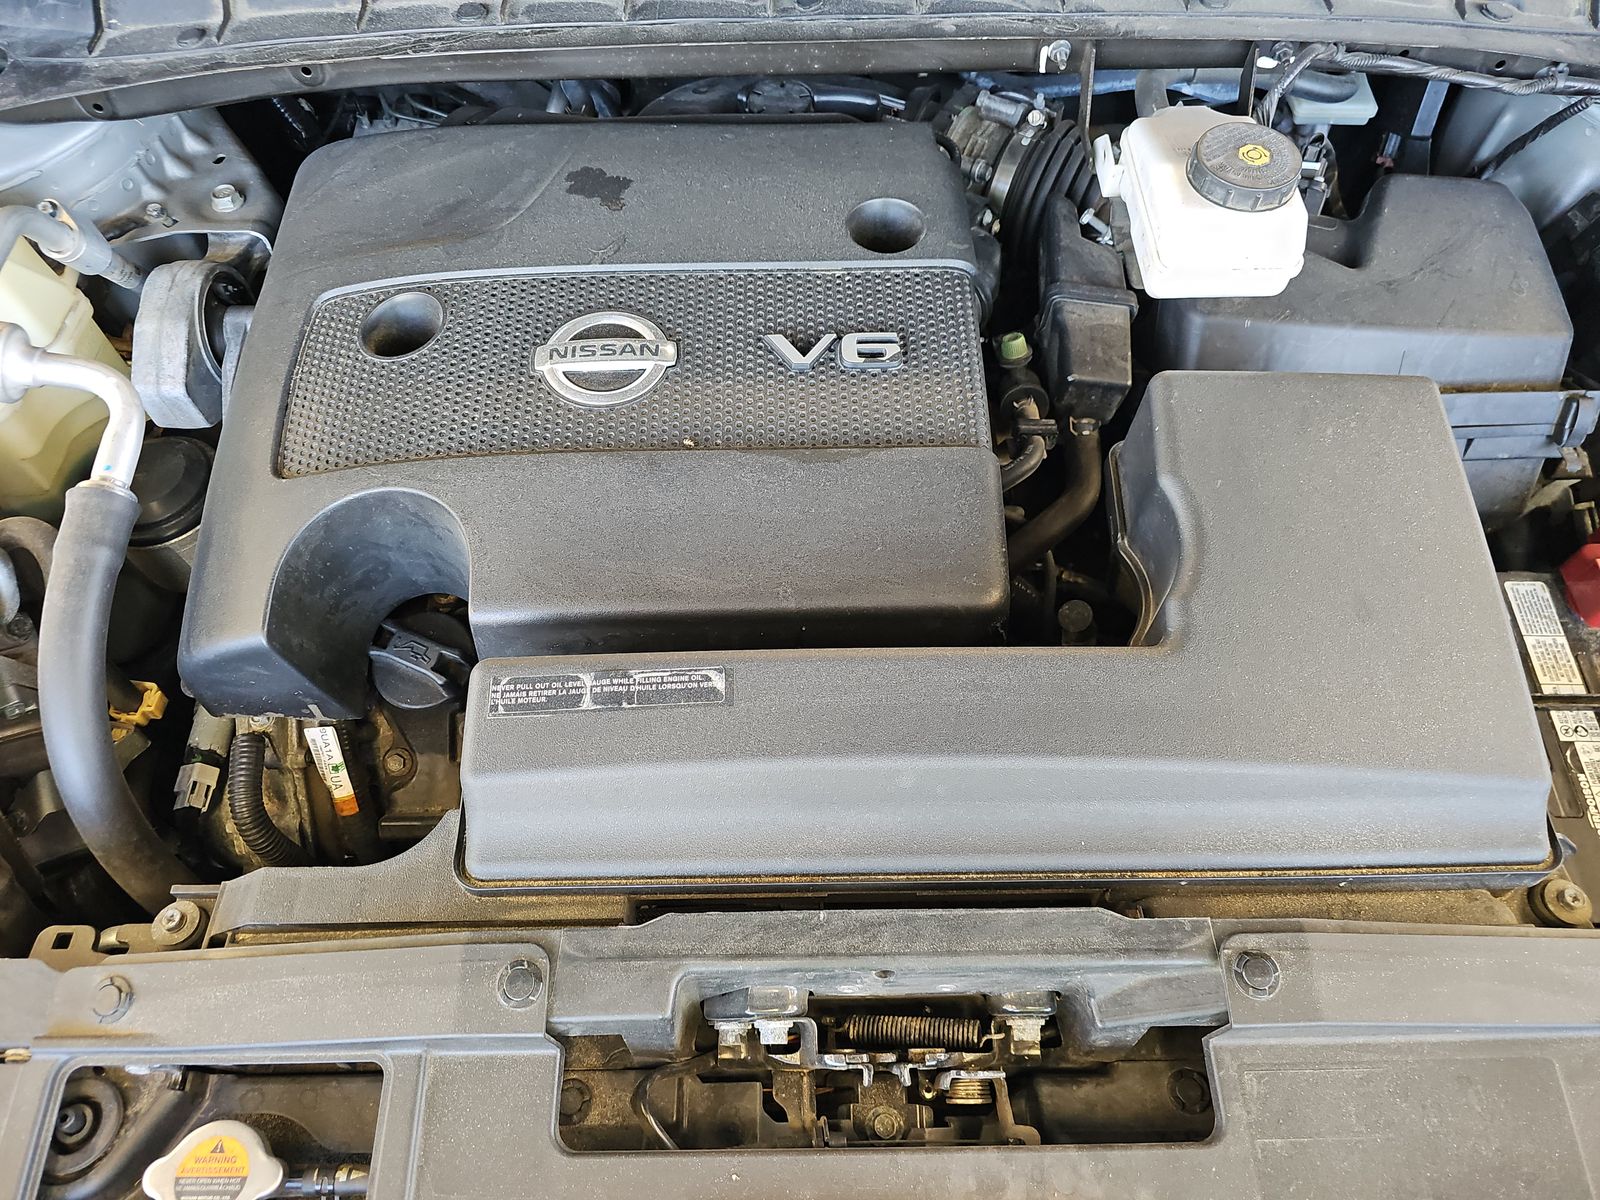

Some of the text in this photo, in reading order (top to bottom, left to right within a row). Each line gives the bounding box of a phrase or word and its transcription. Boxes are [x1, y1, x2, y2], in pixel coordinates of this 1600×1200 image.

[549, 332, 902, 372] NISSAN V6
[492, 684, 515, 692] NEVER
[516, 683, 533, 691] PULL
[535, 682, 550, 690] OUT
[551, 681, 563, 689] OIL
[564, 680, 585, 688] LEVEL
[586, 678, 611, 686] AUGE
[612, 677, 635, 685] WHILE
[636, 676, 661, 685] FILLING
[663, 675, 690, 683] ENGINE
[502, 691, 527, 699] JAMAIS
[529, 689, 557, 697] RETIRER
[592, 686, 602, 694] DE
[603, 685, 628, 693] NIVEAU
[658, 682, 698, 690] LORSQU'ON
[491, 698, 516, 706] L'HUILE
[330, 775, 344, 791] UA
[194, 1155, 237, 1164] WARNING
